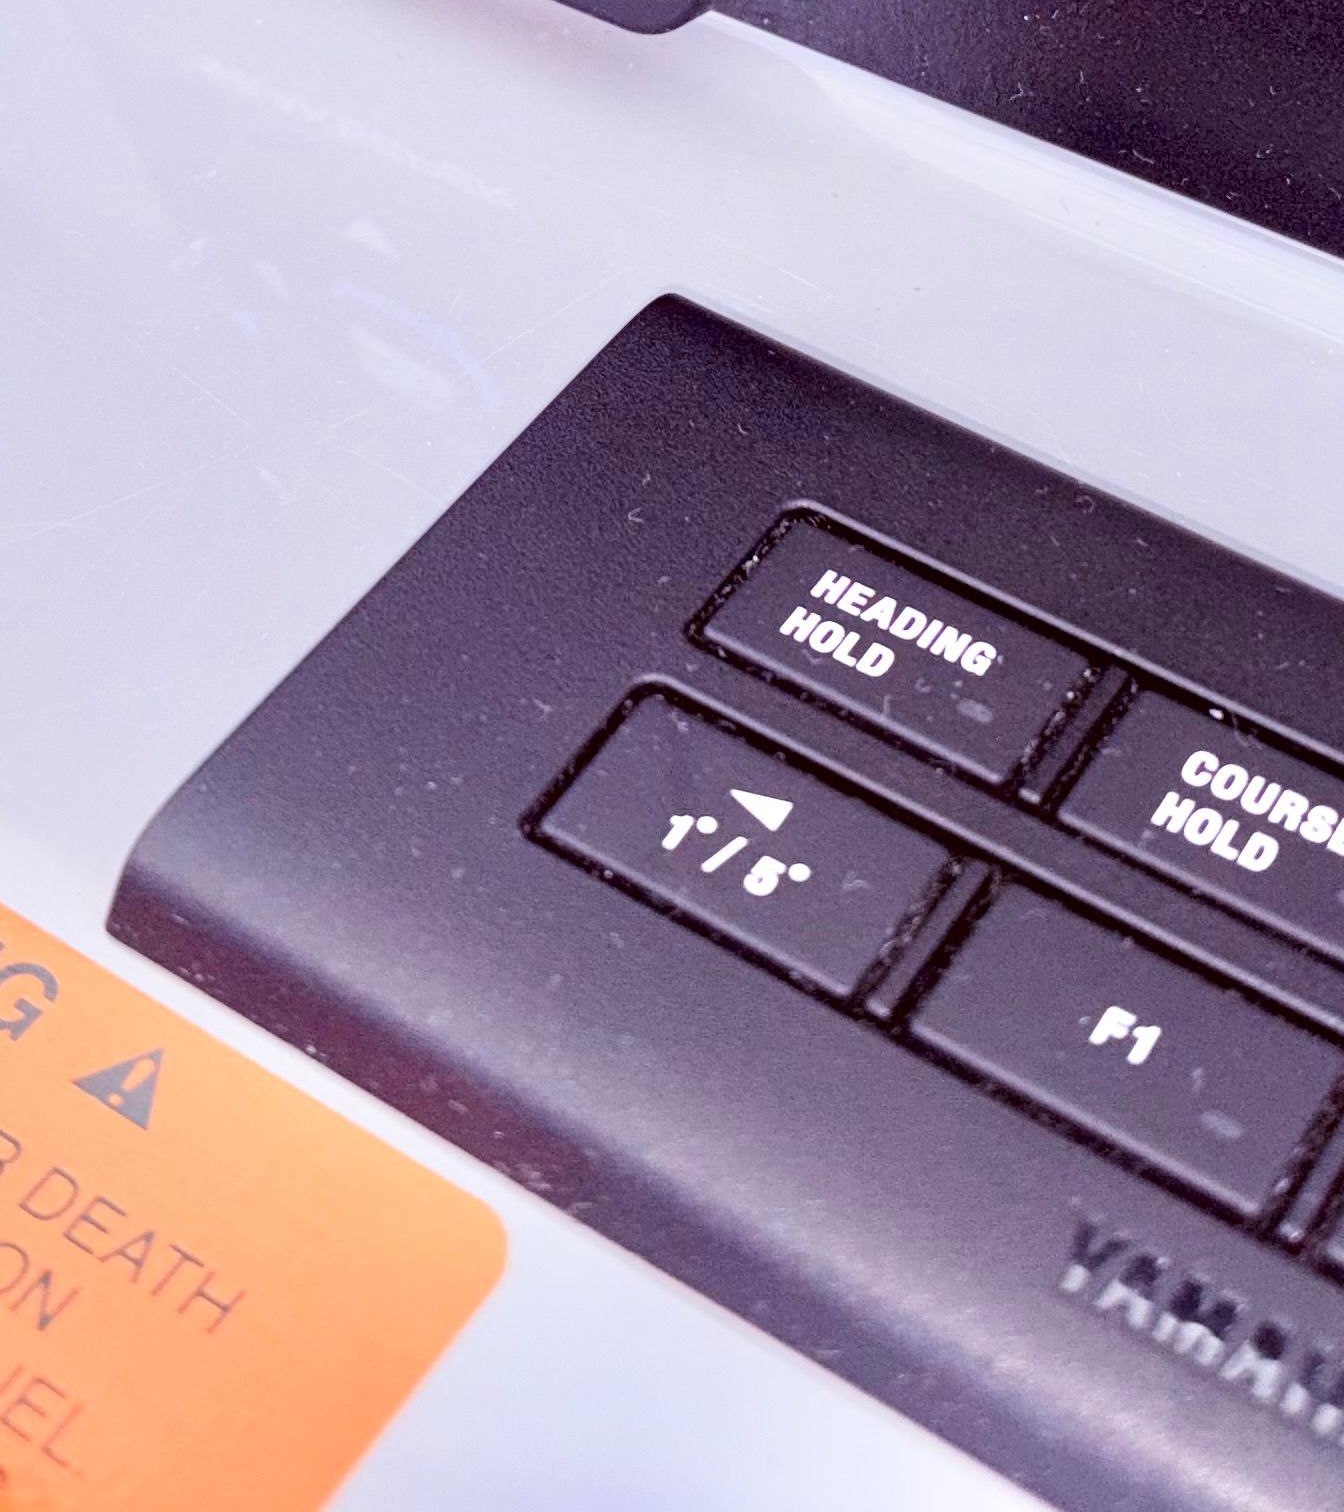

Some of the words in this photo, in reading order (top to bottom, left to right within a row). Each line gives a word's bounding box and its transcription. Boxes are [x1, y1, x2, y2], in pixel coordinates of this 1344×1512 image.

[780, 605, 896, 680] HOLD
[811, 569, 999, 676] HEADING
[1152, 792, 1281, 874] HOLD
[1089, 1006, 1163, 1066] F1
[19, 1168, 247, 1335] DEATH
